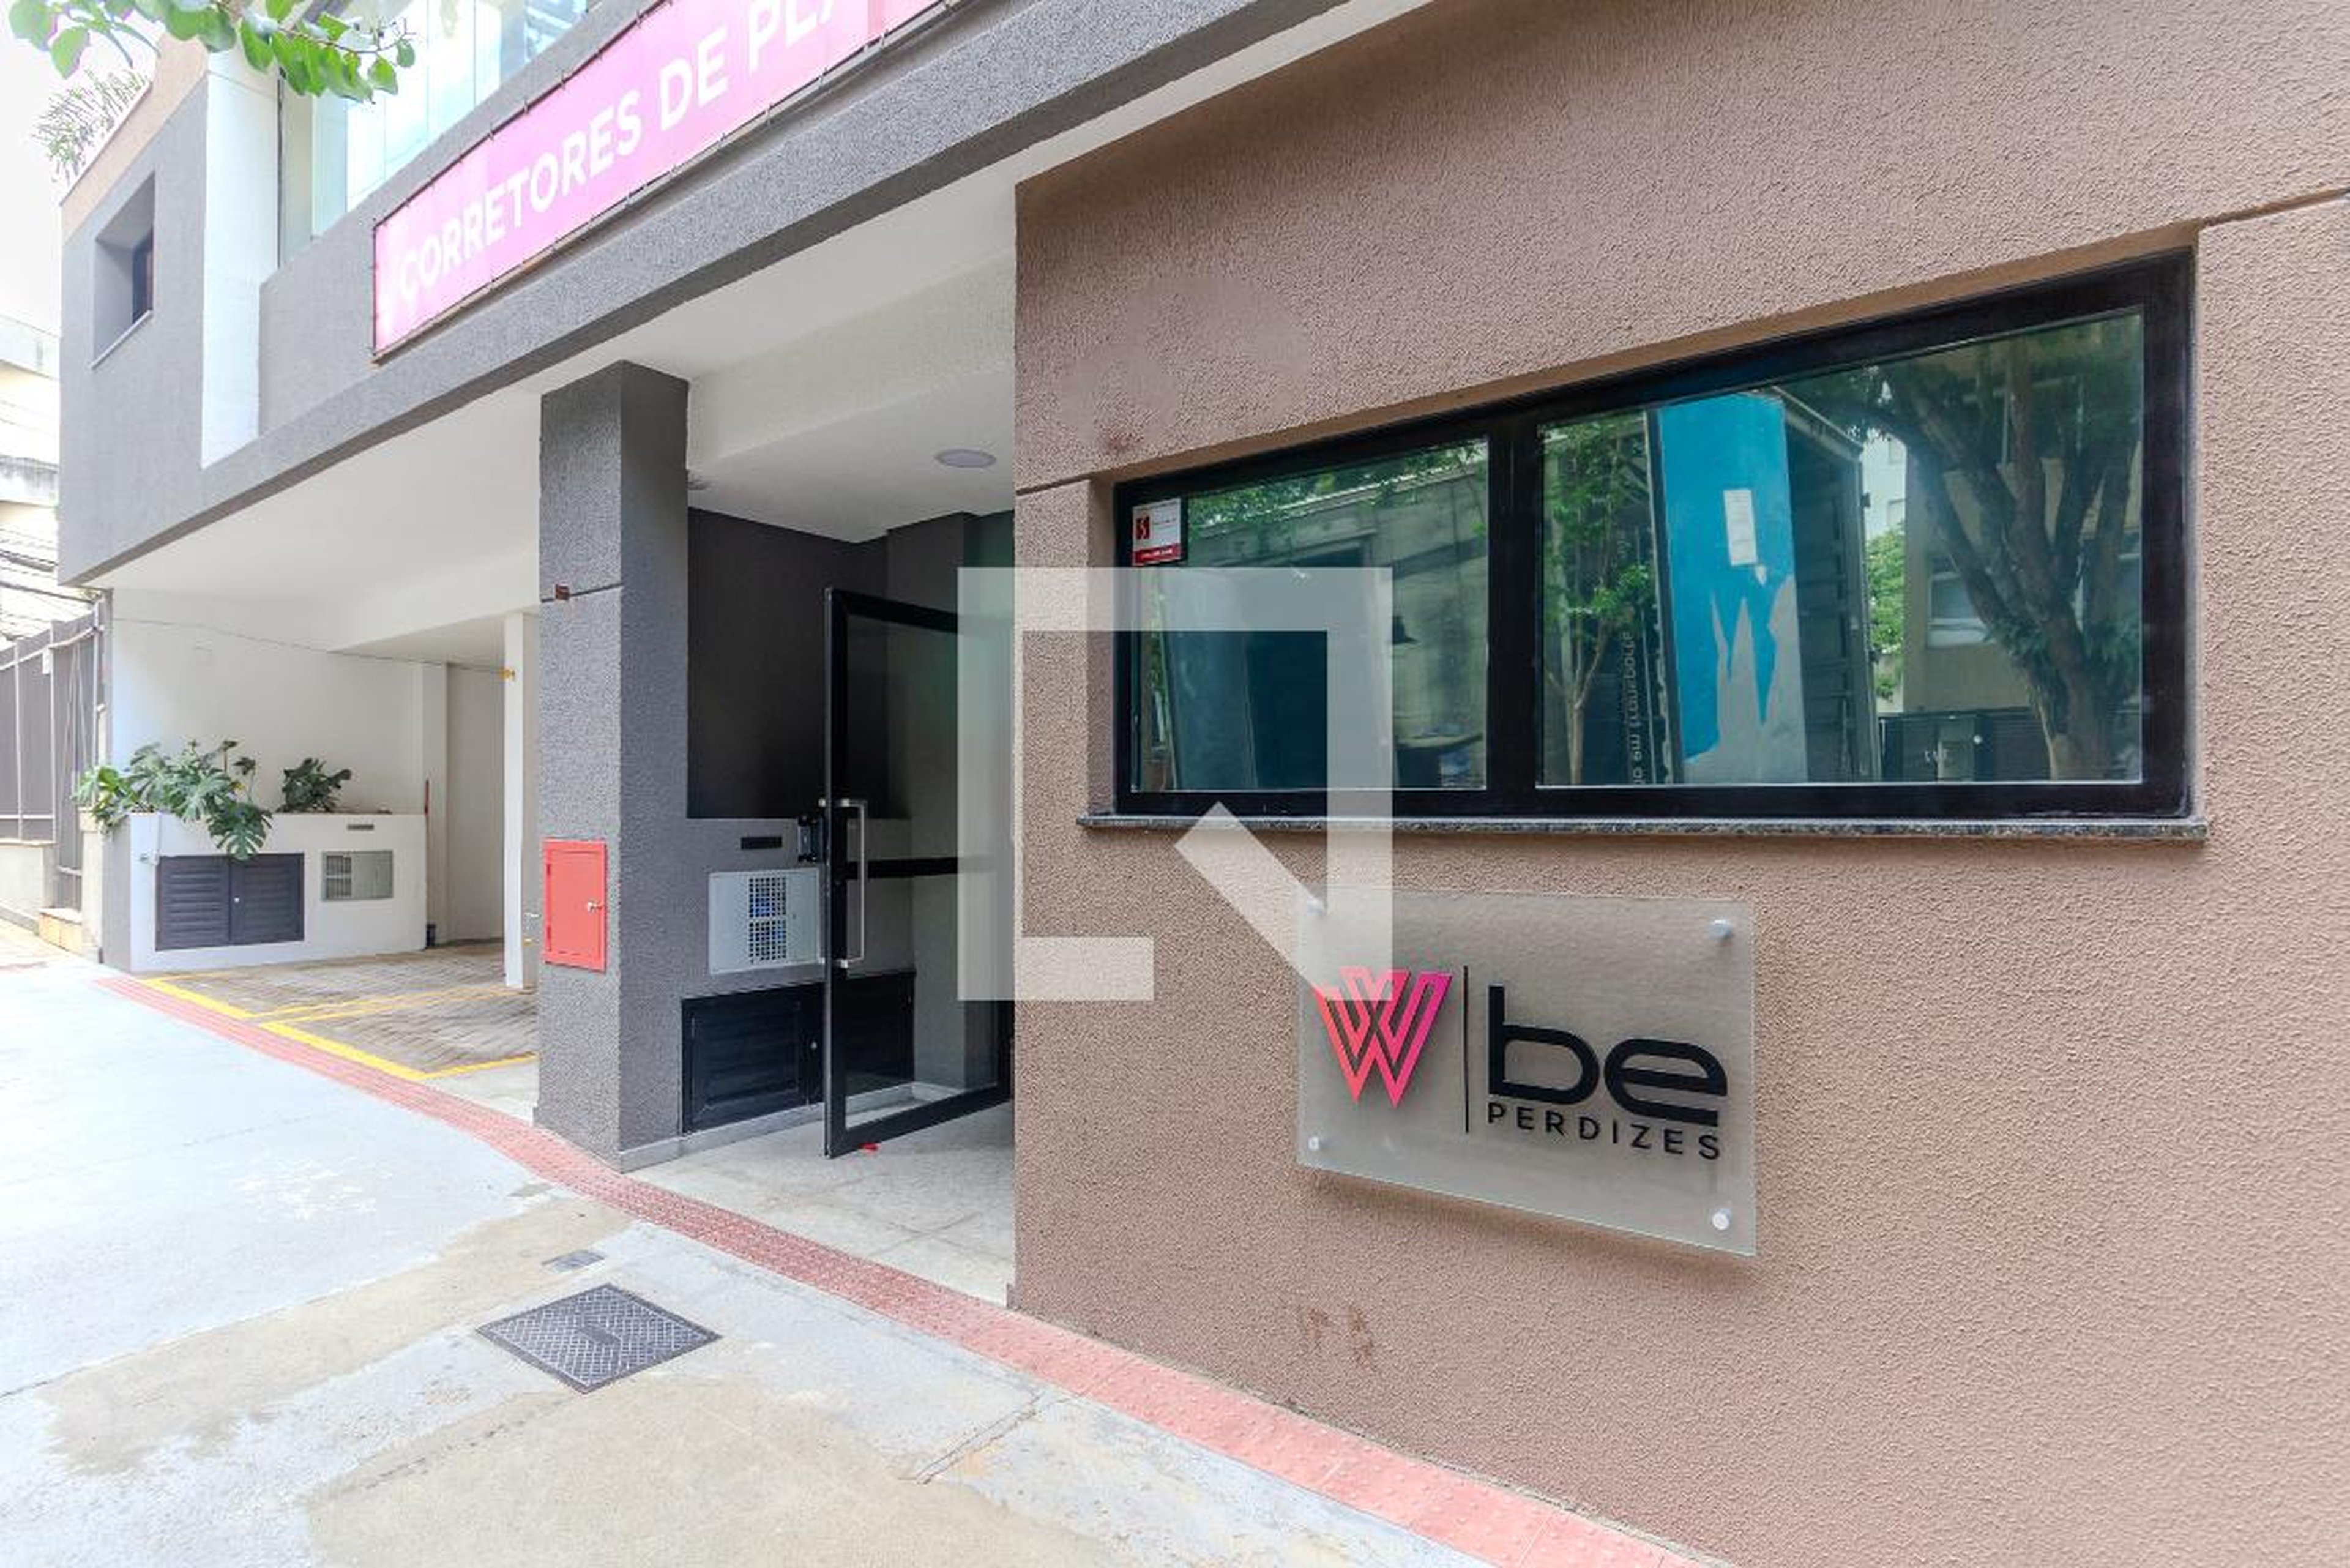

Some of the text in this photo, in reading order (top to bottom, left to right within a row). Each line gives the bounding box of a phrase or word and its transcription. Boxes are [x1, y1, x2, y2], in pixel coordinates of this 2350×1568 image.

[398, 89, 644, 301] CORRETORES
[659, 23, 728, 132] DE
[1488, 984, 1728, 1127] be
[1488, 1102, 1721, 1160] PERDIZES
